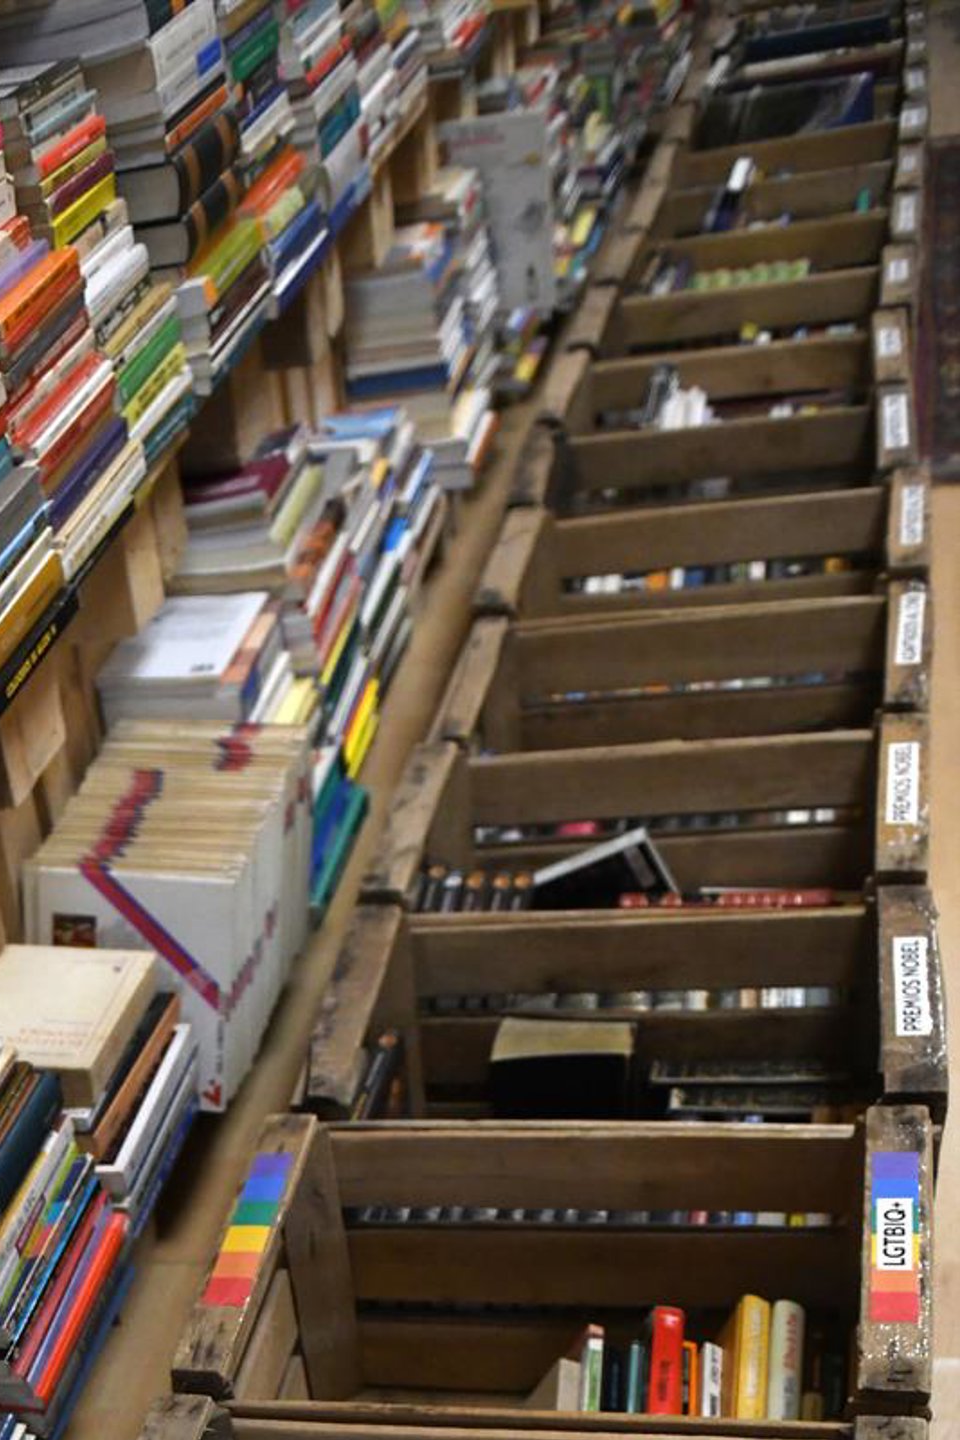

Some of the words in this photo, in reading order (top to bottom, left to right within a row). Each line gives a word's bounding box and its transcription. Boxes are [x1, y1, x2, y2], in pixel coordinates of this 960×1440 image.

[893, 745, 913, 775] NOBEL
[892, 778, 911, 822] PREMIOS
[900, 940, 920, 971] NOBEL
[902, 975, 922, 1032] PREMIOS
[882, 1201, 907, 1267] LGTBIQ+
